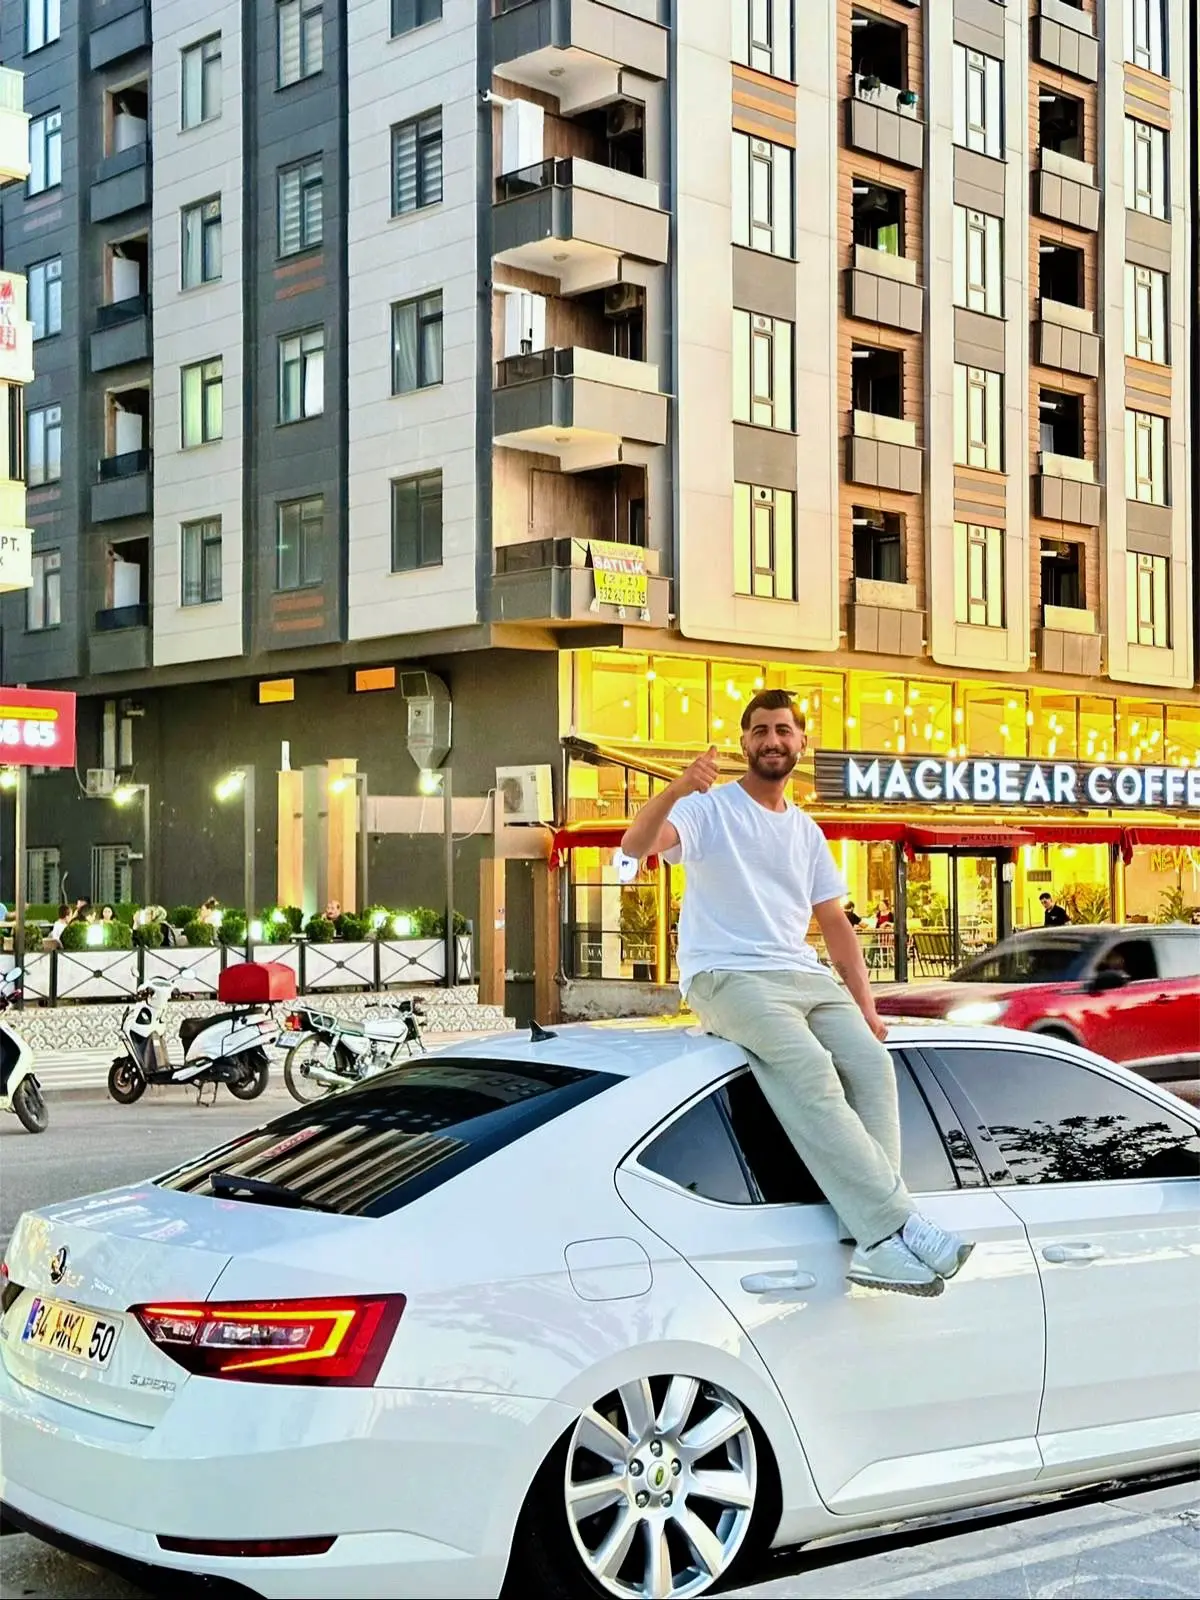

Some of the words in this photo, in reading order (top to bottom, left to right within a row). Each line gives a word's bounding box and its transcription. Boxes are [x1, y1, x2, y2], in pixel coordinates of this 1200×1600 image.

[849, 757, 1077, 803] MACKBEAR
[1087, 766, 1200, 807] COFFE
[31, 1305, 52, 1343] 34
[88, 1320, 115, 1362] 50
